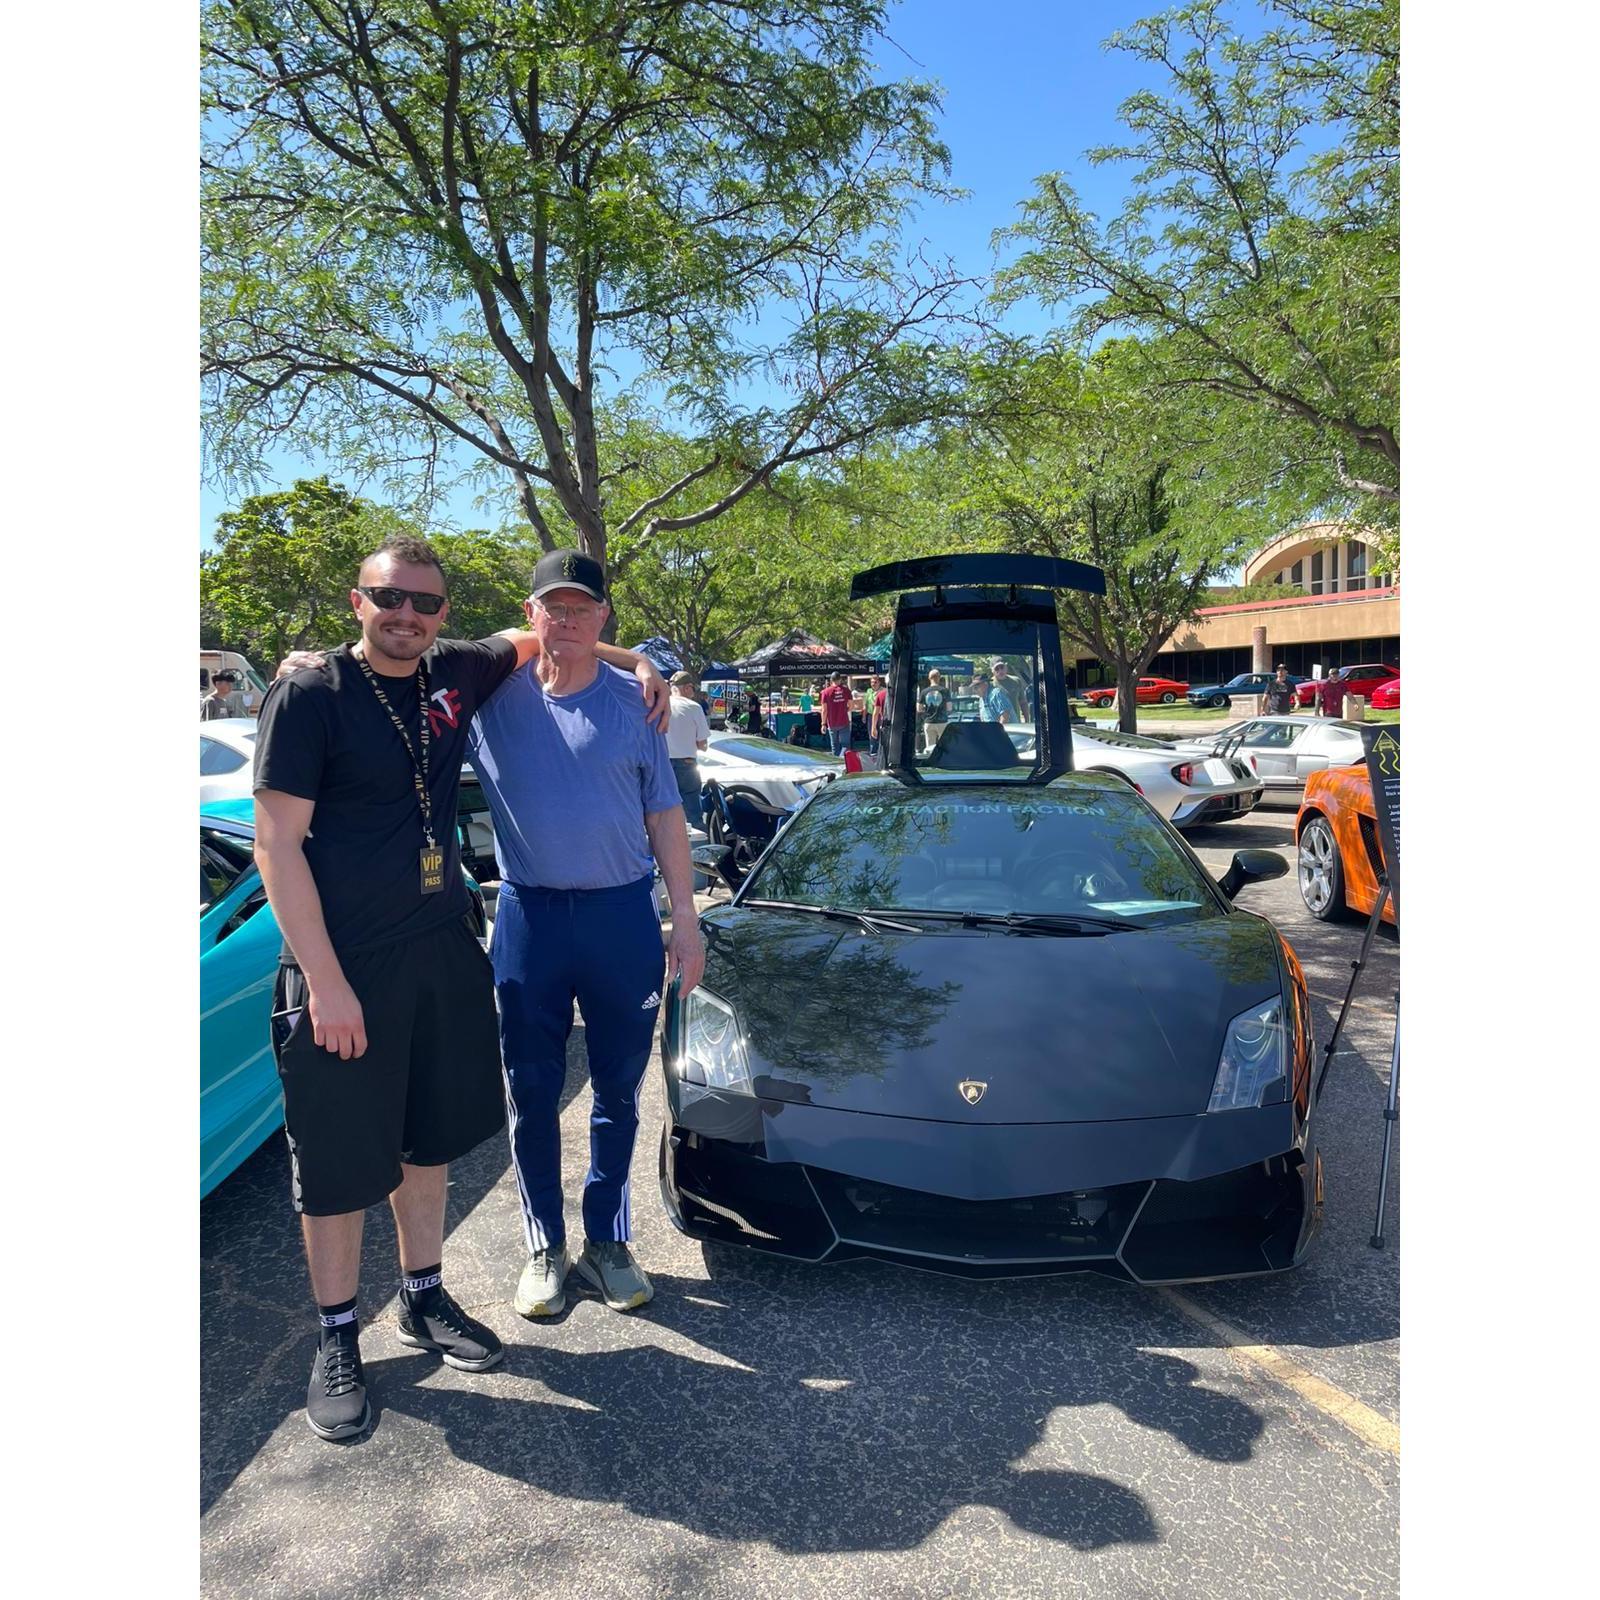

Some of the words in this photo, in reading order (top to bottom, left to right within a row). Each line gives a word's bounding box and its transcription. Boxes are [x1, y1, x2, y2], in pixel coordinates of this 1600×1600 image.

[360, 662, 373, 678] VIP
[797, 663, 827, 671] MOTORCYCLE
[374, 689, 389, 704] VIP
[420, 701, 429, 716] VIP
[391, 715, 405, 730] VIP
[420, 729, 430, 745] VIP
[414, 773, 424, 789] VIP
[852, 806, 884, 816] NO
[891, 804, 1000, 815] TRACTION
[1006, 804, 1105, 817] FACTION
[424, 876, 441, 887] PASS
